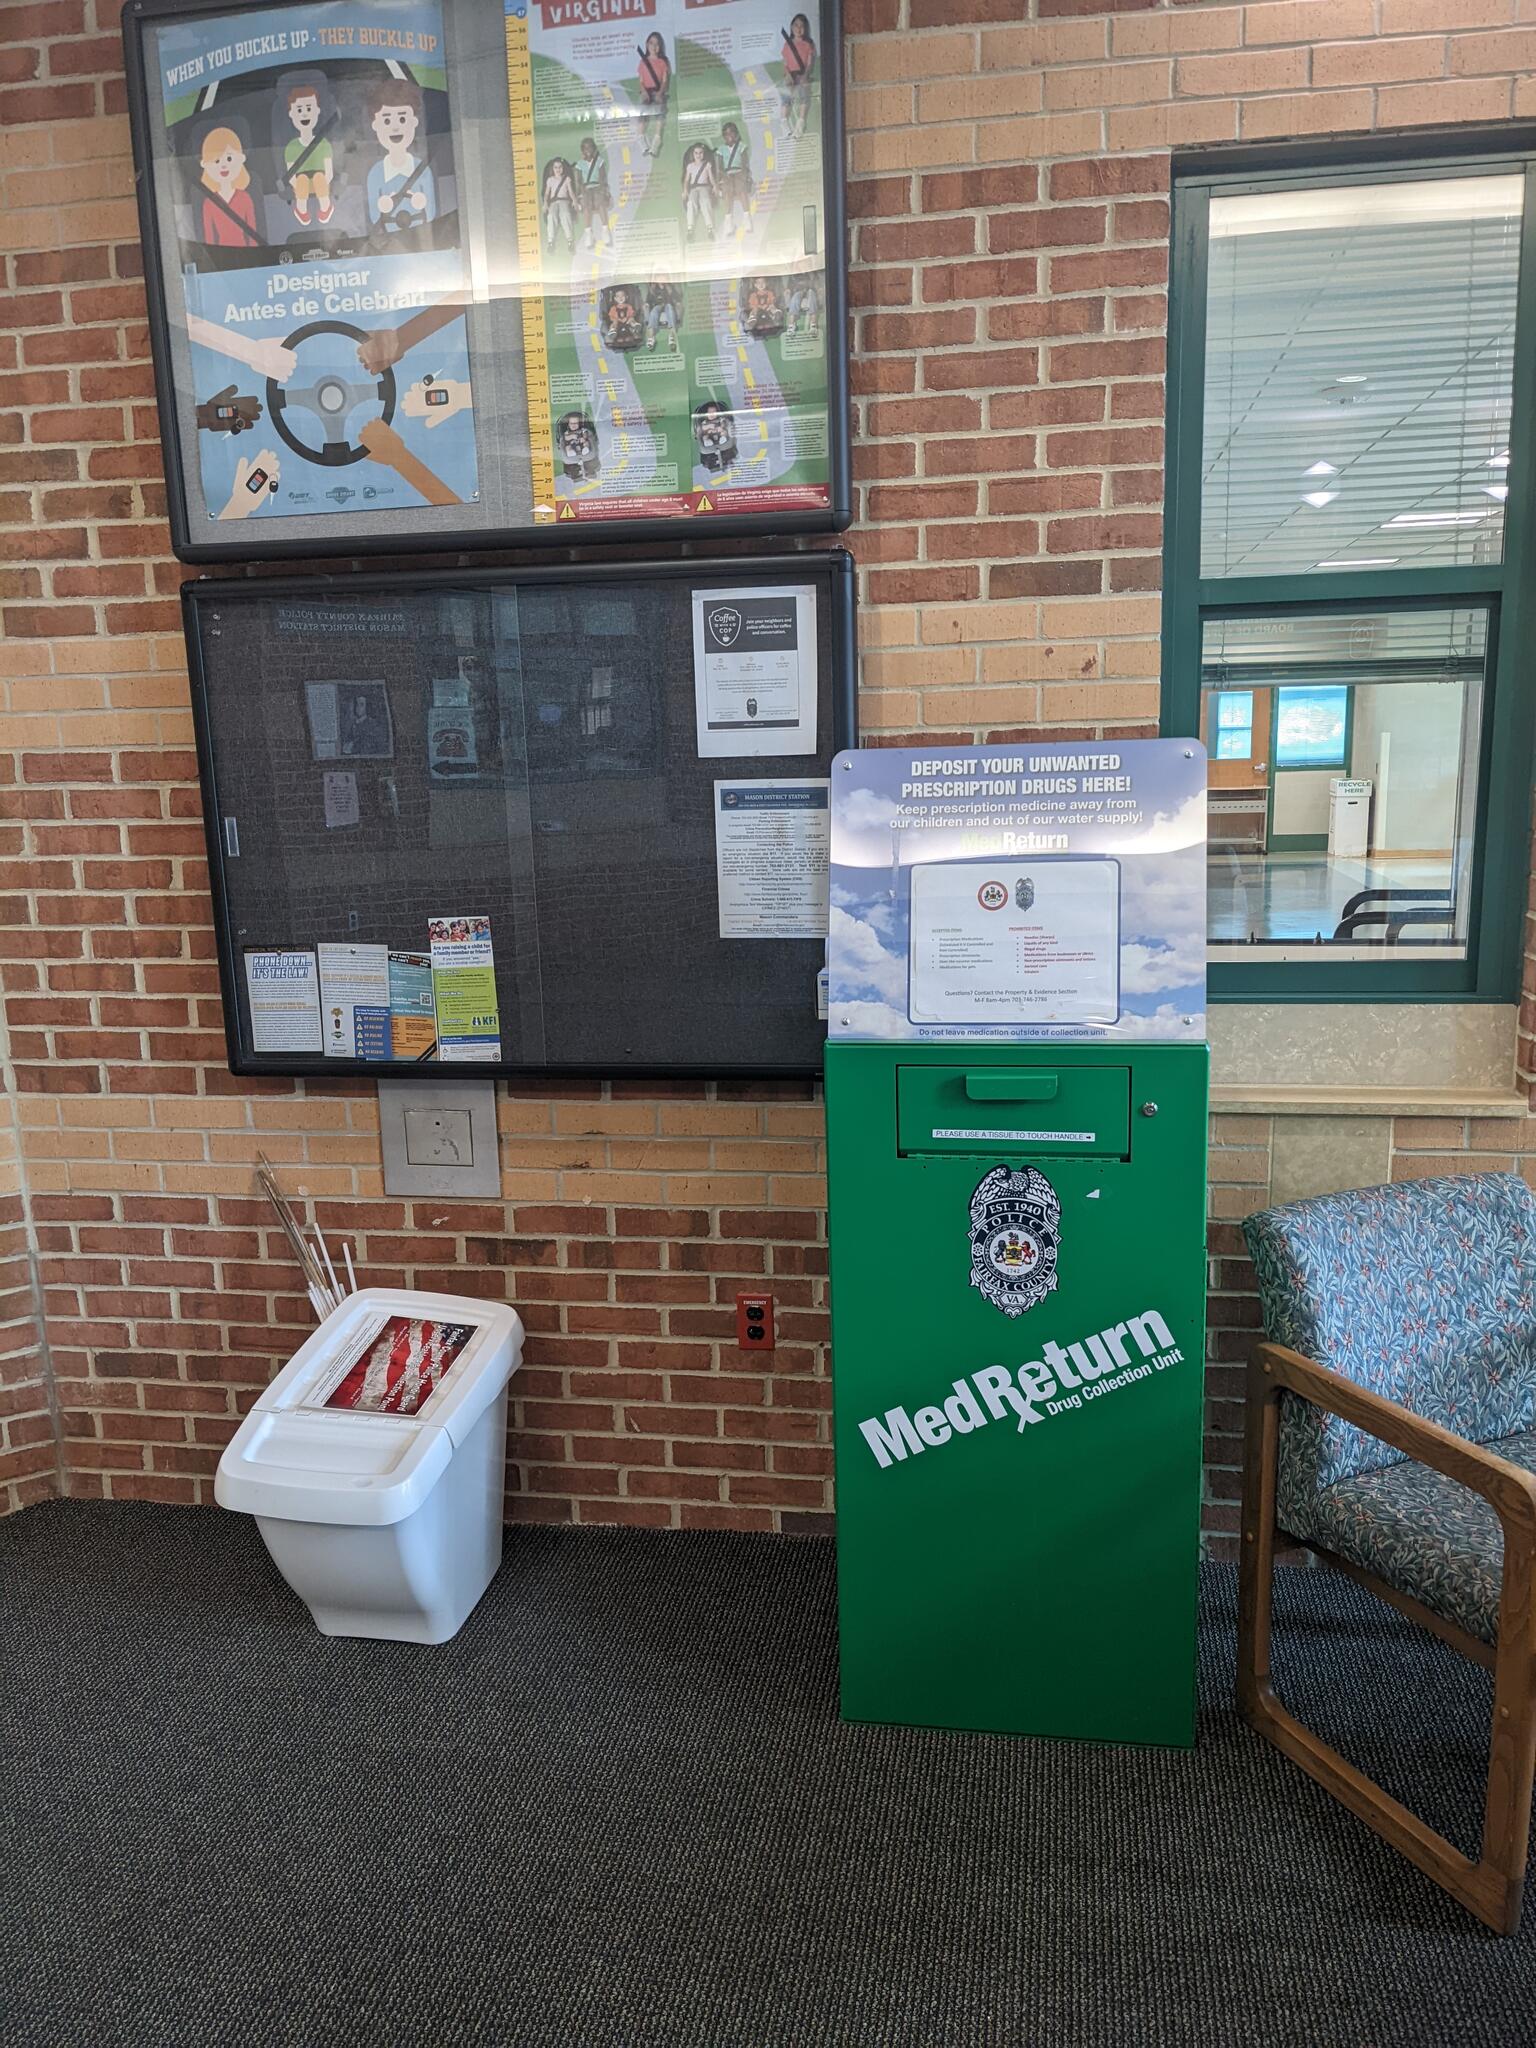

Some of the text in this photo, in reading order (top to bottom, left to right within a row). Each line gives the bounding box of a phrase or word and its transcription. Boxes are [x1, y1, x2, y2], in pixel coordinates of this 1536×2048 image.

[549, 0, 646, 24] VIRGINIA
[318, 27, 438, 53] THEY BUCKLE UP
[166, 30, 310, 87] WHEN YOU BUCKLE UP
[267, 270, 371, 299] ¡Designar
[224, 303, 286, 323] Antes
[292, 297, 319, 317] de
[714, 613, 736, 623] Coffee
[911, 754, 1121, 777] DEPOSIT YOUR UNWANTED
[901, 775, 1131, 799] PRESCRIPTION DRUGS HERE!
[895, 798, 1137, 816] Keep prescription medicine away from
[889, 811, 1144, 829] our children and out of our water supply!
[960, 832, 1069, 856] MedReturn
[252, 955, 313, 967] PHONE DOWN...
[252, 967, 309, 979] IT'S THE LAW!
[1005, 989, 1028, 997] Property
[482, 1016, 497, 1026] KFI
[966, 1028, 1010, 1036] medication
[1027, 1132, 1053, 1140] TOUCH
[1054, 1133, 1084, 1141] HANDLE
[989, 1202, 1041, 1216] EST. 1940
[981, 1214, 1048, 1238] POLICE
[974, 1257, 1054, 1291] FAIRFAX COUNTY
[1006, 1296, 1023, 1304] VA.
[446, 1327, 464, 1345] Fairfax
[410, 1378, 428, 1395] Honor
[857, 1309, 1176, 1469] MedReturn
[1045, 1347, 1185, 1416] Drug Collection Unit
[377, 1396, 395, 1411] Point
[395, 1394, 415, 1411] Guard
